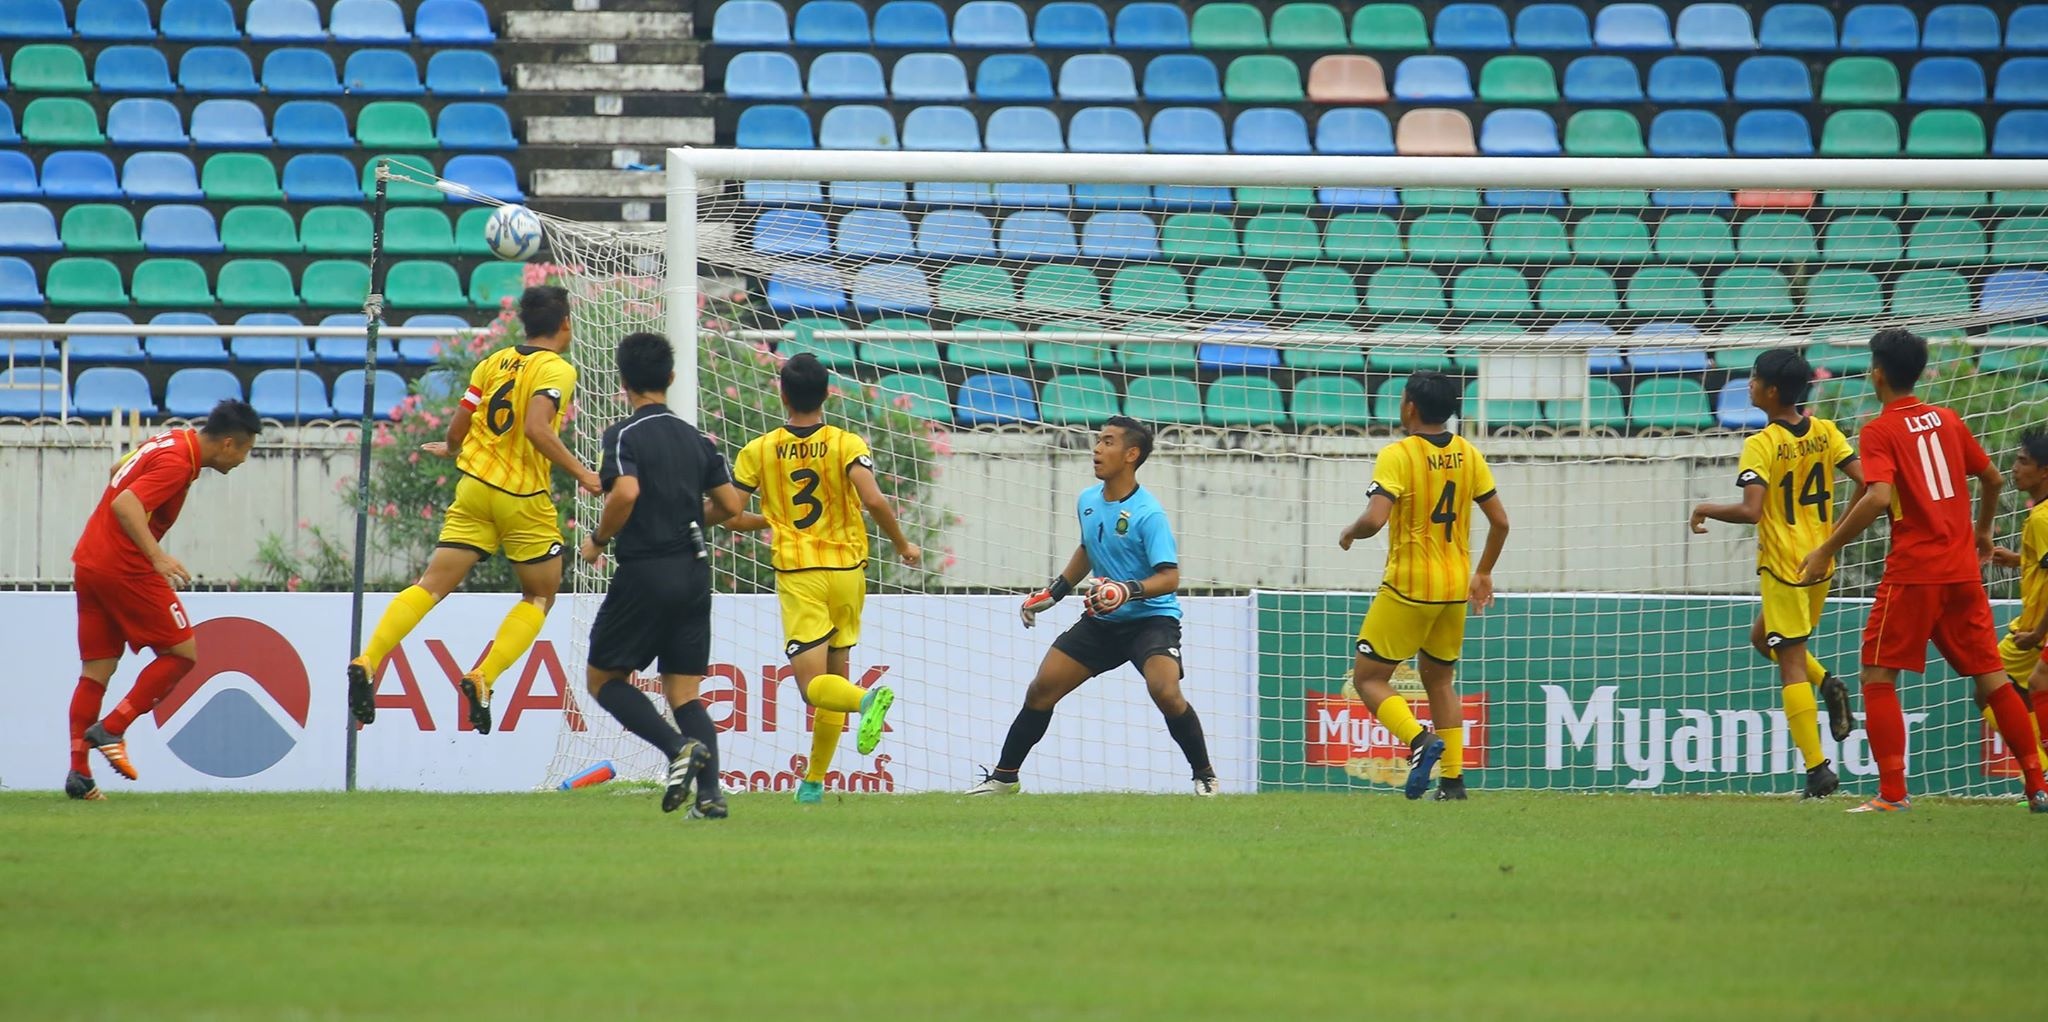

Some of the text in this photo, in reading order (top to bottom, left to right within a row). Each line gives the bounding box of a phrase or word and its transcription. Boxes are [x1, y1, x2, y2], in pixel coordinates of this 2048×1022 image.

[487, 378, 515, 436] 6
[776, 441, 828, 460] WADUD
[1427, 453, 1464, 471] NAZIF
[1917, 431, 1955, 501] 11
[790, 468, 823, 529] 3
[1431, 480, 1457, 542] 4
[1779, 462, 1831, 525] 14
[1098, 522, 1104, 543] 1
[169, 602, 187, 630] 6
[356, 639, 588, 731] AYA
